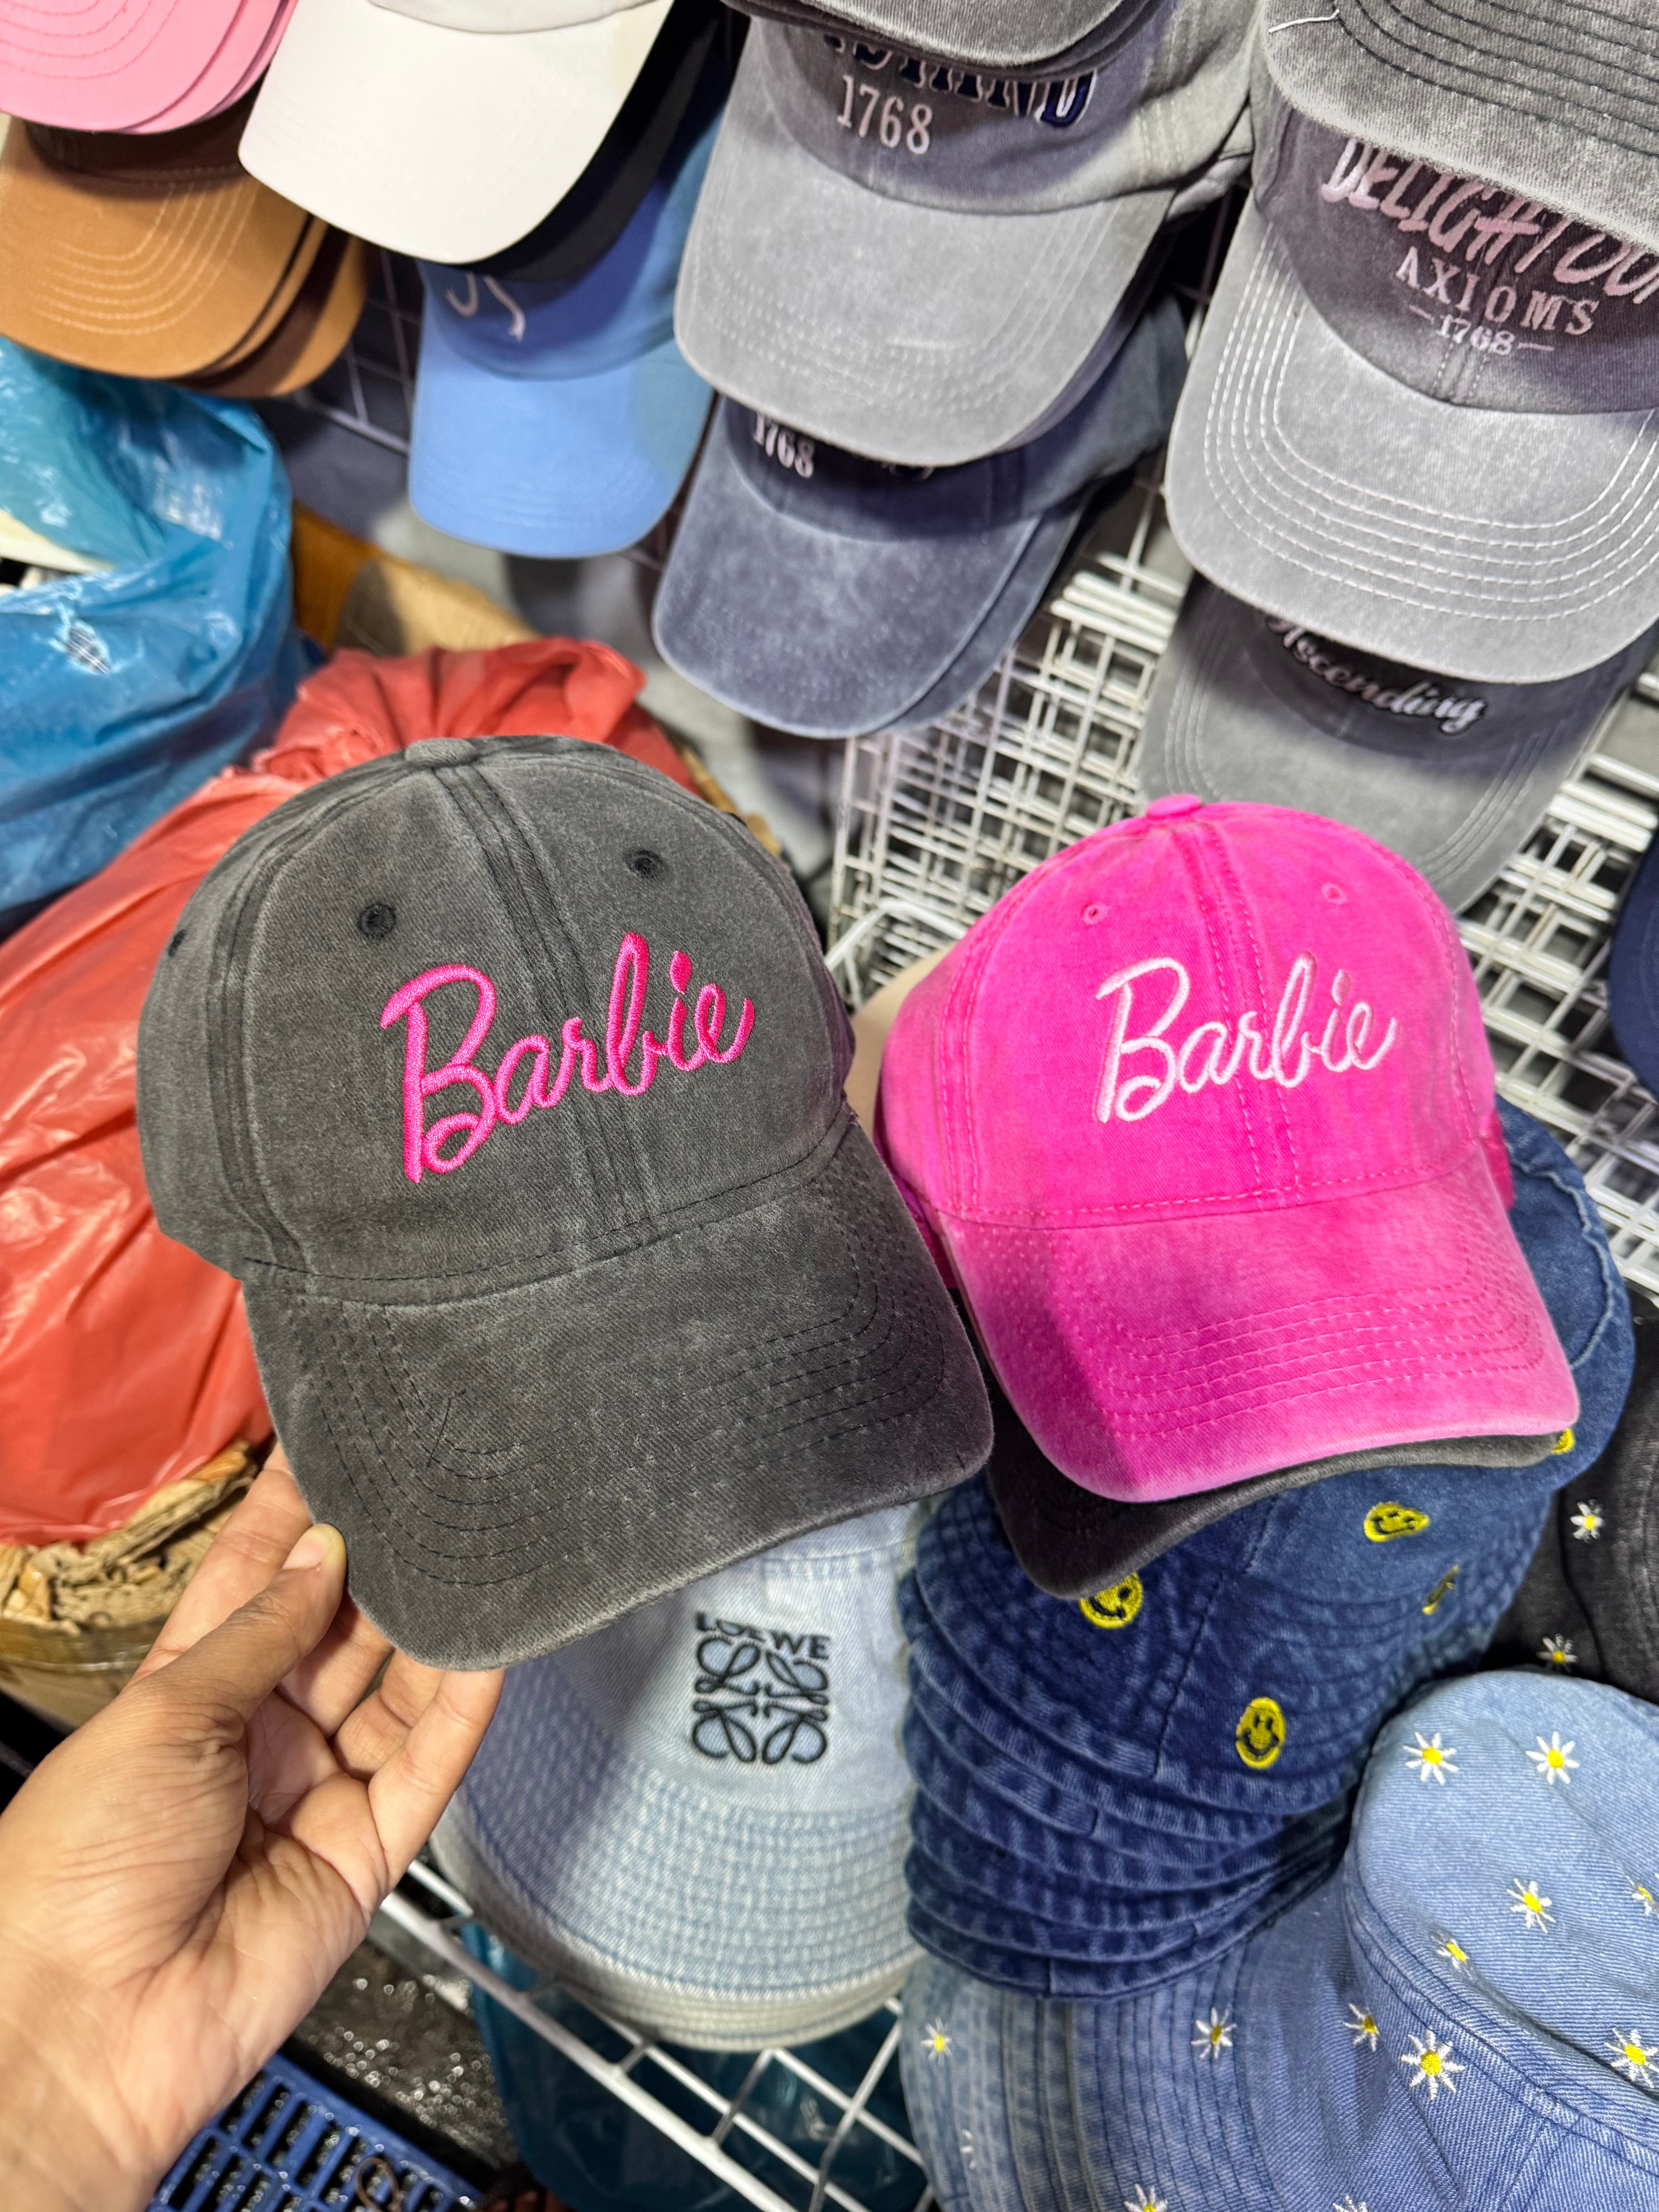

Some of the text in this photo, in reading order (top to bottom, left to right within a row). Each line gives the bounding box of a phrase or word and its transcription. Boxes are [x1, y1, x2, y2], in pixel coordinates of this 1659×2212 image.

[836, 75, 933, 154] 1768
[1396, 246, 1599, 335] AXIOMS
[380, 932, 754, 1183] Barbie
[1094, 950, 1398, 1123] Barbie
